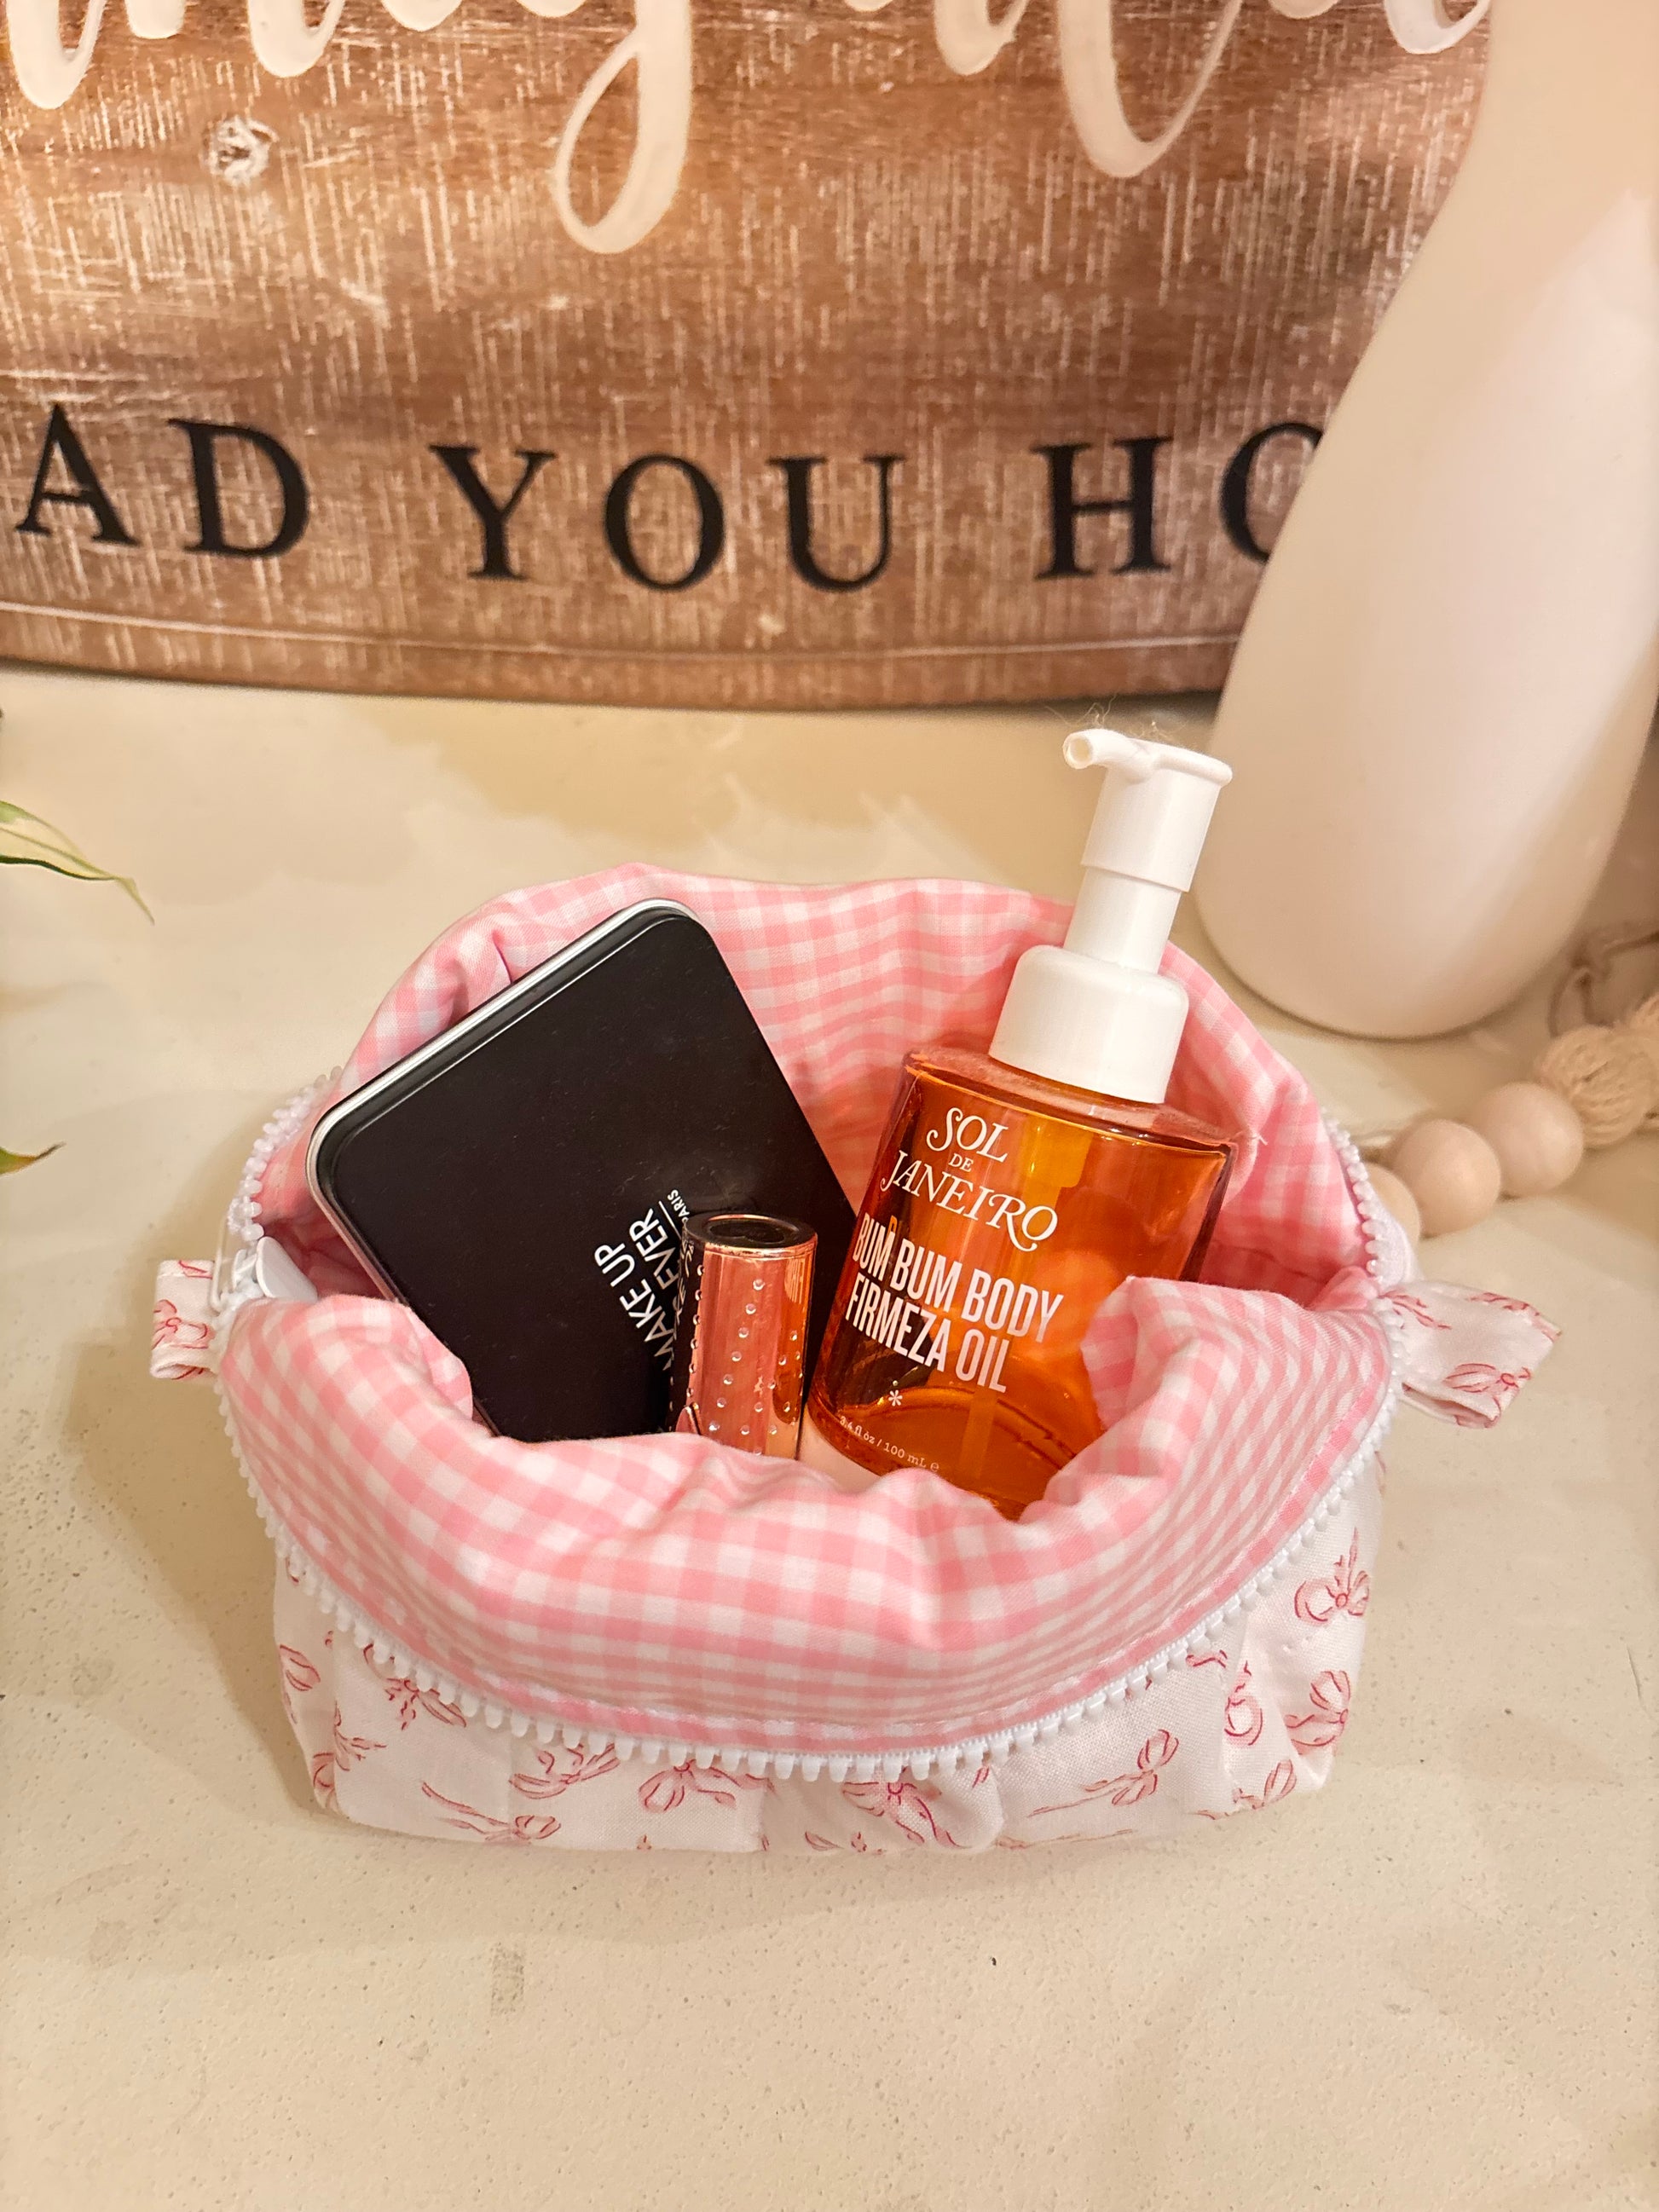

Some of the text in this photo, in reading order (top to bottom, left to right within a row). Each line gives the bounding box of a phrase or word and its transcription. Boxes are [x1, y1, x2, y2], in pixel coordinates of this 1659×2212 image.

[429, 443, 906, 593] YOU
[927, 1107, 1009, 1163] SOL
[948, 1153, 974, 1172] DE
[880, 1150, 1058, 1252] JANEIRO
[594, 1244, 635, 1288] UP
[853, 1212, 1064, 1343] BUM BUM BODY
[845, 1272, 1010, 1394] FIRMEZA OIL
[883, 1442, 905, 1458] 100
[907, 1454, 927, 1468] mL
